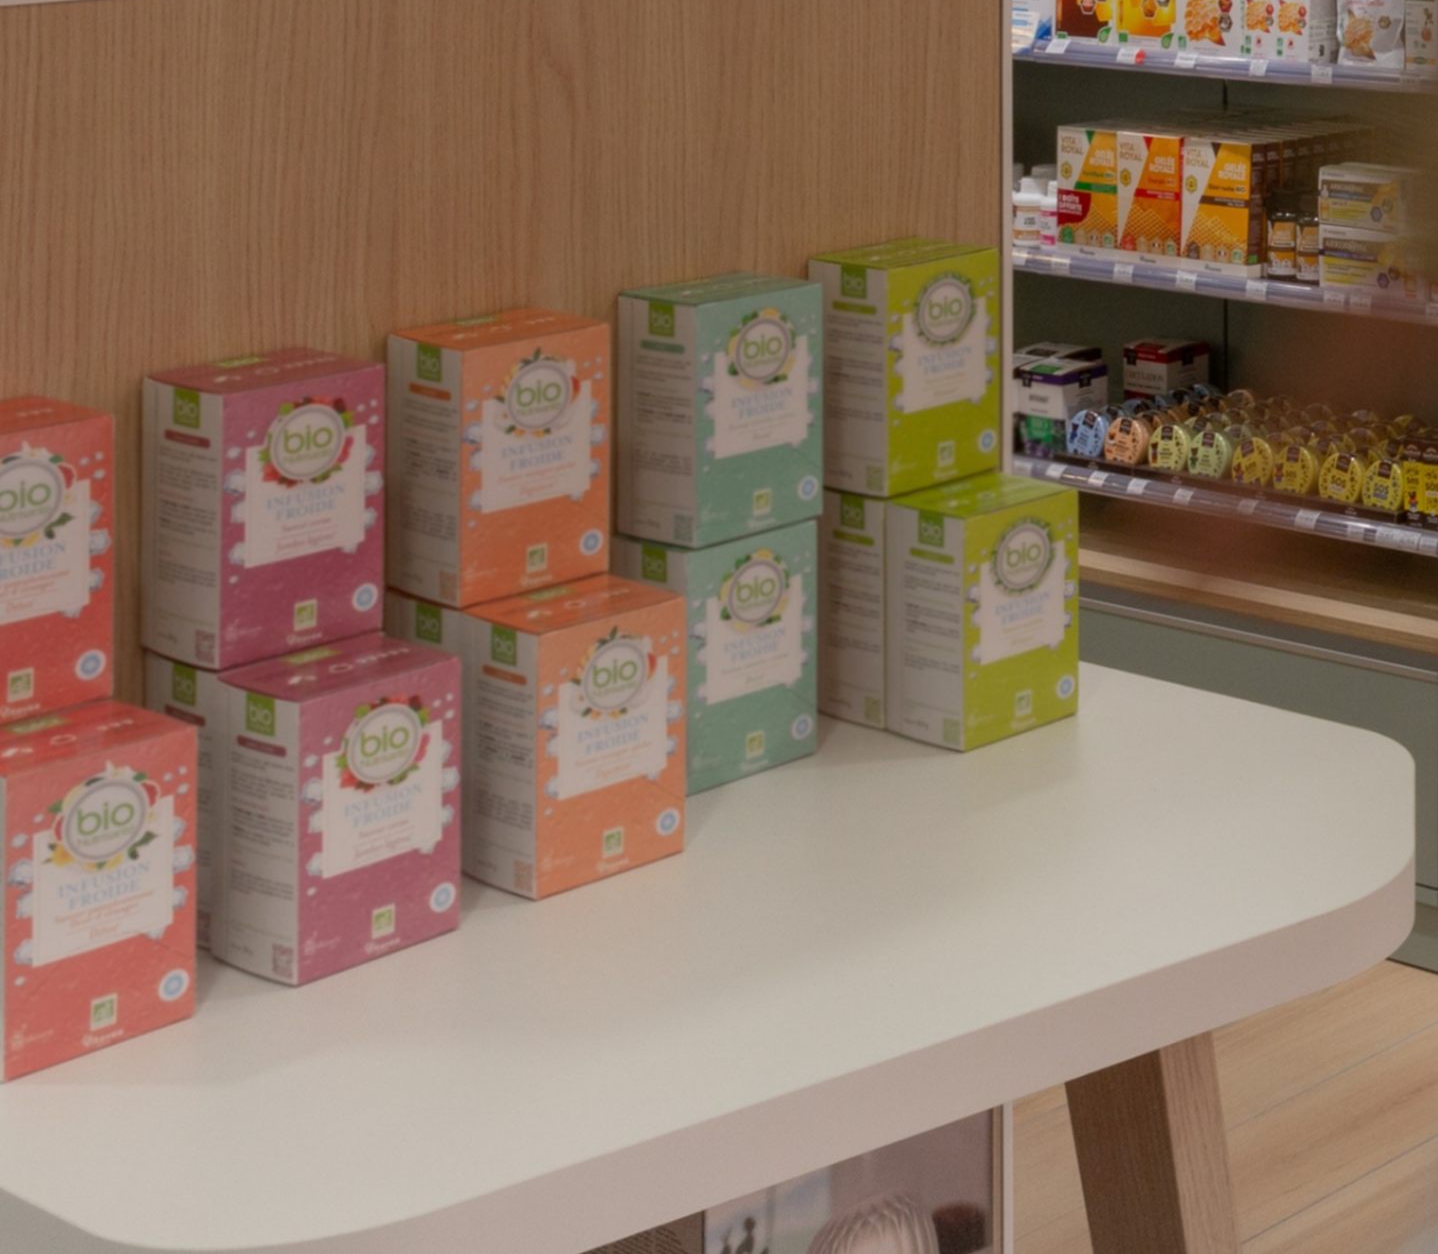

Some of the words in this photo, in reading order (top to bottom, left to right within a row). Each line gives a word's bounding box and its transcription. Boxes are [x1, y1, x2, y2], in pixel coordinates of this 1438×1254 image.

[515, 377, 563, 410] bio
[282, 424, 333, 455] bio
[501, 434, 573, 460] INFUSION
[509, 451, 565, 472] FROIDE
[266, 482, 345, 512] INFUSION
[275, 498, 338, 523] FROIDE
[735, 574, 777, 603] bio
[592, 656, 639, 689] bio
[358, 723, 410, 758] bio
[576, 712, 649, 748] INFUSION
[343, 782, 424, 816] INFUSION
[352, 799, 415, 828] FROIDE
[76, 800, 135, 837] bio
[57, 859, 151, 900] INFUSION
[67, 879, 142, 912] FROIDE
